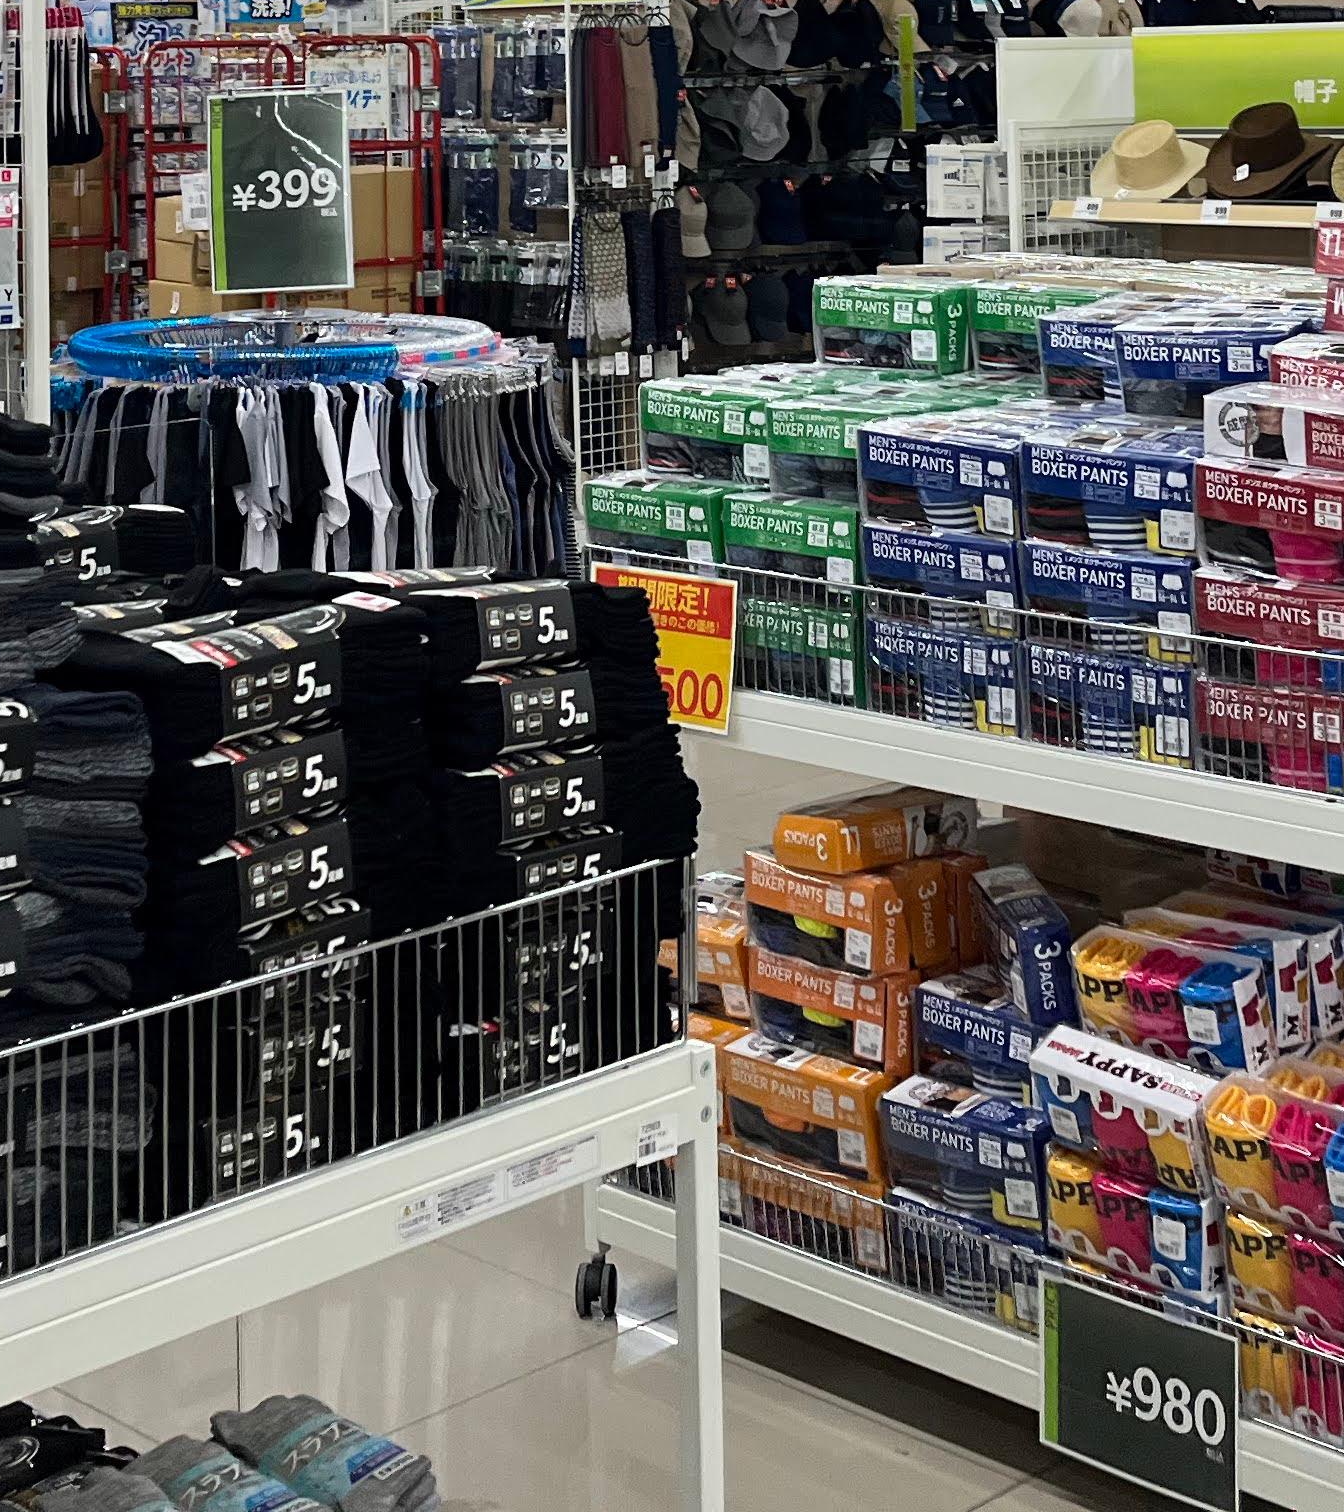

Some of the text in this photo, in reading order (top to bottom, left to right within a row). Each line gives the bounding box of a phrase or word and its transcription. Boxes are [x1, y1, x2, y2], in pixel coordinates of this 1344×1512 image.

[1293, 77, 1340, 105] 帽子
[232, 167, 338, 212] ¥399
[820, 297, 890, 315] BOXER PANTS
[1123, 345, 1222, 364] BOXER PANTS
[647, 401, 720, 424] BOXER PANTS
[869, 447, 955, 475] BOXER PANTS
[1031, 460, 1129, 487] BOXER PANTS
[1206, 484, 1308, 515] BOXER PANTS
[730, 513, 804, 536] BOXER PANTS
[873, 543, 956, 569] BOXER PANTS
[1032, 562, 1126, 589] BOXER PANTS
[1207, 596, 1311, 626] BOXER PANTS
[751, 870, 824, 904] BOXER PANTS
[1034, 941, 1062, 1011] 3 PACKS
[922, 1007, 1005, 1046] BOXER PANTS
[1076, 1051, 1160, 1090] SAPPY
[890, 1116, 974, 1153] BOXER PANTS
[1106, 1366, 1227, 1446] ¥980
